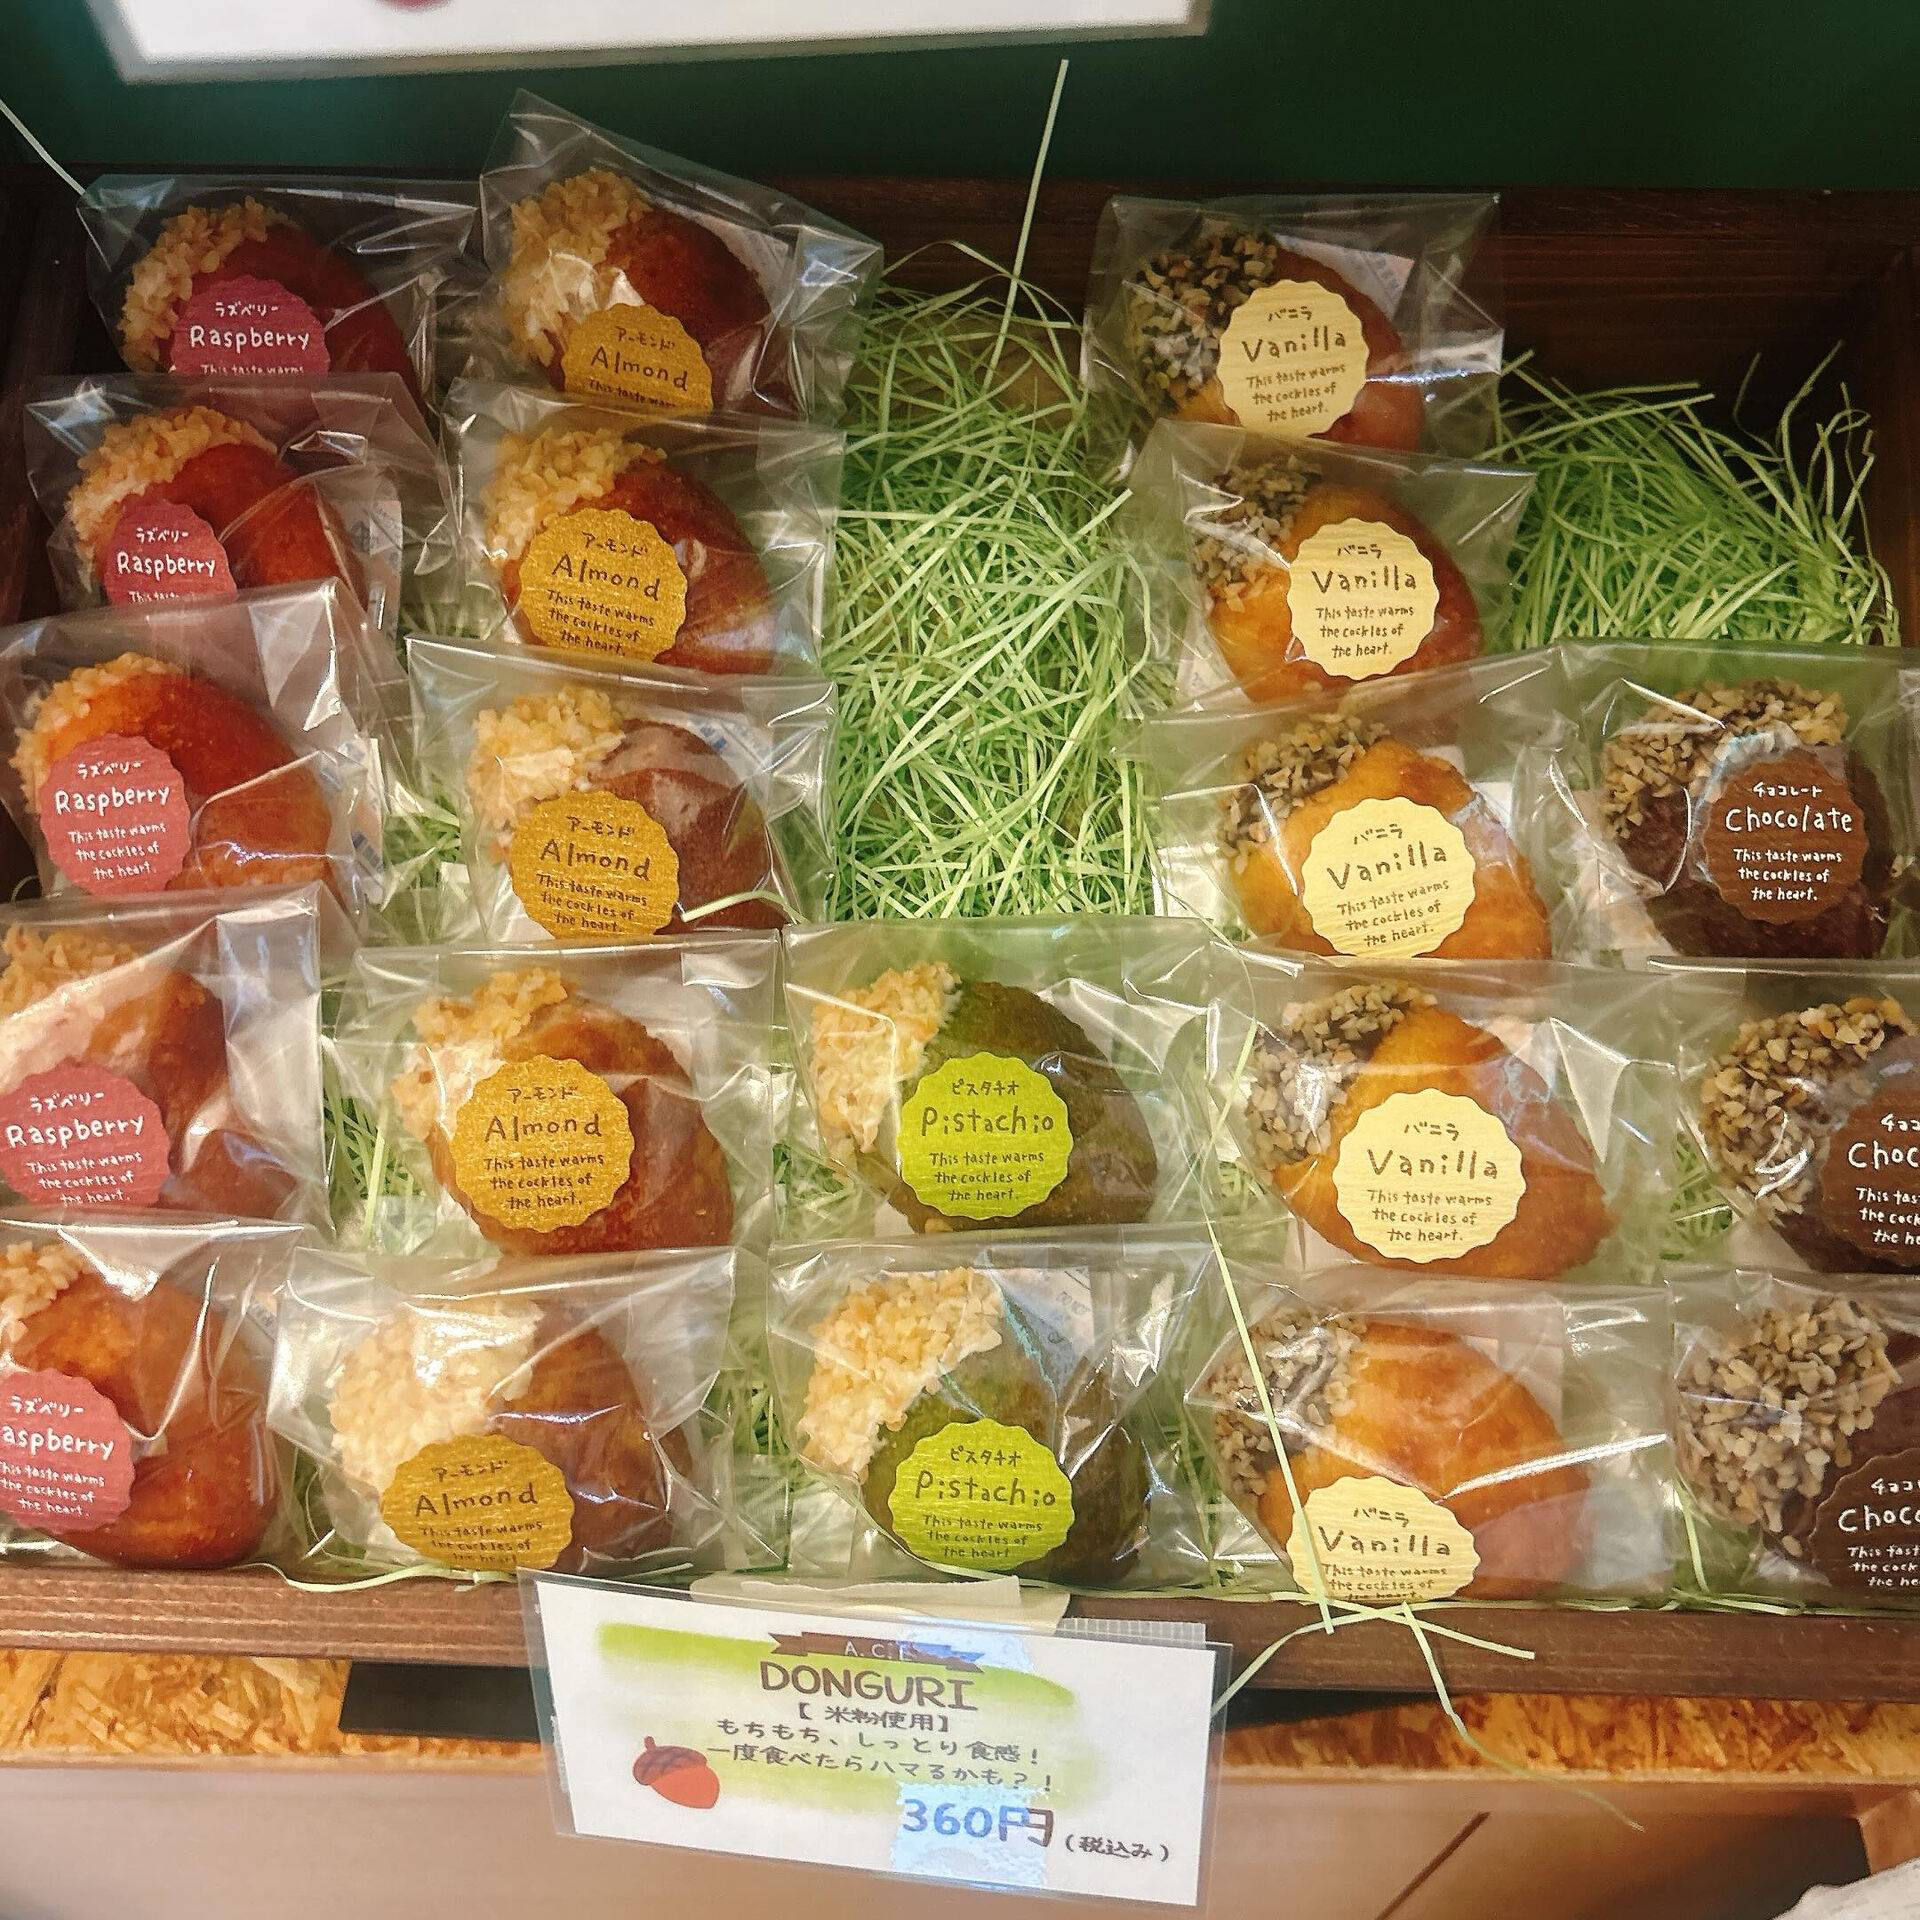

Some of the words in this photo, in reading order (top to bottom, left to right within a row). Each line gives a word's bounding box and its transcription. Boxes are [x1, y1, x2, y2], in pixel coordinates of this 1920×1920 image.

[215, 301, 279, 317] ラズベリー
[1268, 306, 1313, 321] バニラ
[190, 325, 309, 353] Raspberry
[616, 326, 675, 350] アーモンド
[1242, 325, 1346, 363] Vanilla
[591, 346, 687, 391] Almond
[1246, 377, 1272, 389] This
[1276, 370, 1305, 384] taste
[1310, 364, 1345, 378] warms
[1252, 393, 1272, 405] the
[1276, 387, 1320, 403] cockles
[1324, 382, 1336, 394] of
[1267, 410, 1286, 422] the
[1291, 402, 1328, 418] heart.
[136, 527, 188, 543] ラズベリー
[582, 531, 648, 557] アーモンド
[1338, 544, 1383, 559] バニラ
[117, 551, 215, 581] Raspberry
[552, 553, 660, 601] Almond
[1311, 565, 1417, 594] Vanilla
[547, 589, 573, 605] This
[578, 597, 611, 616] taste
[615, 609, 655, 626] warms
[1316, 608, 1341, 621] This
[1345, 606, 1375, 619] taste
[1378, 606, 1414, 617] warms
[549, 609, 572, 623] the
[573, 616, 621, 637] cockles
[626, 631, 641, 642] of
[1320, 627, 1339, 638] the
[1343, 626, 1387, 638] cockles
[1391, 623, 1403, 636] of
[560, 630, 580, 644] the
[585, 636, 625, 656] heart.
[1332, 645, 1351, 658] the
[1356, 643, 1392, 656] heart.
[78, 761, 144, 779] ラズベリー
[1753, 782, 1822, 798] チョコレート
[55, 787, 169, 816] Raspberry
[566, 816, 635, 838] アーモンド
[1725, 805, 1852, 833] Chocolate
[68, 831, 93, 844] This
[96, 825, 126, 842] taste
[130, 823, 166, 835] warms
[1354, 823, 1403, 845] バニラ
[76, 850, 96, 862] the
[99, 845, 145, 860] cockles
[147, 841, 159, 854] of
[540, 838, 650, 882] Almond
[1733, 849, 1761, 863] This
[1765, 850, 1798, 863] taste
[1802, 852, 1842, 863] warms
[93, 867, 114, 880] the
[117, 861, 157, 878] heart.
[1326, 840, 1447, 890] Vanilla
[1738, 867, 1759, 880] the
[1763, 869, 1811, 882] cockles
[1816, 869, 1830, 883] of
[537, 873, 564, 888] This
[569, 880, 602, 897] taste
[607, 891, 647, 906] warms
[1337, 901, 1366, 916] This
[1370, 891, 1404, 909] taste
[1408, 880, 1449, 899] warms
[1751, 887, 1772, 900] the
[1777, 887, 1817, 901] heart.
[541, 892, 561, 906] the
[566, 899, 616, 917] cockles
[621, 911, 634, 920] of
[1346, 919, 1368, 931] the
[1372, 907, 1424, 926] cockles
[1428, 900, 1442, 913] of
[554, 913, 575, 925] the
[581, 917, 622, 932] heart.
[1364, 933, 1386, 947] the
[1392, 922, 1434, 941] heart.
[30, 1092, 104, 1113] ラズベリー
[507, 1086, 578, 1104] アーモンド
[484, 1113, 602, 1142] Almond
[921, 1105, 1054, 1136] Pistachio
[1404, 1121, 1459, 1141] バニラ
[6, 1115, 144, 1149] Raspberry
[26, 1162, 57, 1174] This
[60, 1157, 95, 1172] taste
[98, 1152, 142, 1166] warms
[484, 1158, 513, 1171] This
[518, 1156, 555, 1169] taste
[560, 1154, 604, 1166] warms
[930, 1152, 959, 1167] This
[963, 1152, 997, 1166] taste
[1002, 1152, 1044, 1162] warms
[1367, 1149, 1498, 1180] Vanilla
[38, 1178, 61, 1189] the
[65, 1174, 116, 1189] cockles
[120, 1170, 134, 1183] of
[490, 1176, 513, 1189] the
[518, 1175, 572, 1189] cockles
[578, 1172, 592, 1185] of
[935, 1171, 956, 1183] the
[961, 1172, 1013, 1184] cockles
[1018, 1170, 1031, 1182] of
[60, 1194, 83, 1207] the
[86, 1189, 131, 1203] heart.
[507, 1196, 531, 1209] the
[537, 1192, 582, 1208] heart.
[949, 1190, 971, 1201] the
[976, 1188, 1019, 1200] heart.
[1367, 1189, 1399, 1204] This
[1404, 1191, 1441, 1204] taste
[1445, 1195, 1493, 1205] warms
[1856, 1187, 1889, 1203] This
[1372, 1208, 1396, 1220] the
[1401, 1212, 1456, 1224] cockles
[1462, 1212, 1478, 1225] of
[1859, 1207, 1885, 1223] the
[1387, 1229, 1411, 1242] the
[1418, 1229, 1463, 1241] heart.
[1873, 1229, 1899, 1244] the
[10, 1394, 84, 1418] ラズベリー
[1, 1425, 114, 1461] aspberry
[25, 1465, 59, 1482] taste
[62, 1472, 105, 1487] warms
[431, 1460, 509, 1483] アーモンド
[26, 1485, 77, 1501] cockles
[81, 1491, 95, 1503] of
[915, 1470, 1056, 1507] Pistachio
[18, 1498, 41, 1511] the
[46, 1502, 90, 1517] heart.
[415, 1482, 538, 1517] Almond
[923, 1515, 952, 1527] This
[958, 1517, 994, 1529] taste
[998, 1521, 1042, 1531] warms
[1353, 1507, 1409, 1527] バニラ
[1318, 1526, 1450, 1556] Vanilla
[1847, 1546, 1880, 1558] This
[1849, 1562, 1878, 1572] the
[1868, 1577, 1893, 1586] the
[760, 1660, 978, 1711] DONGURI
[798, 1701, 950, 1733] 【米粉使用】
[902, 1798, 1054, 1848] 360円
